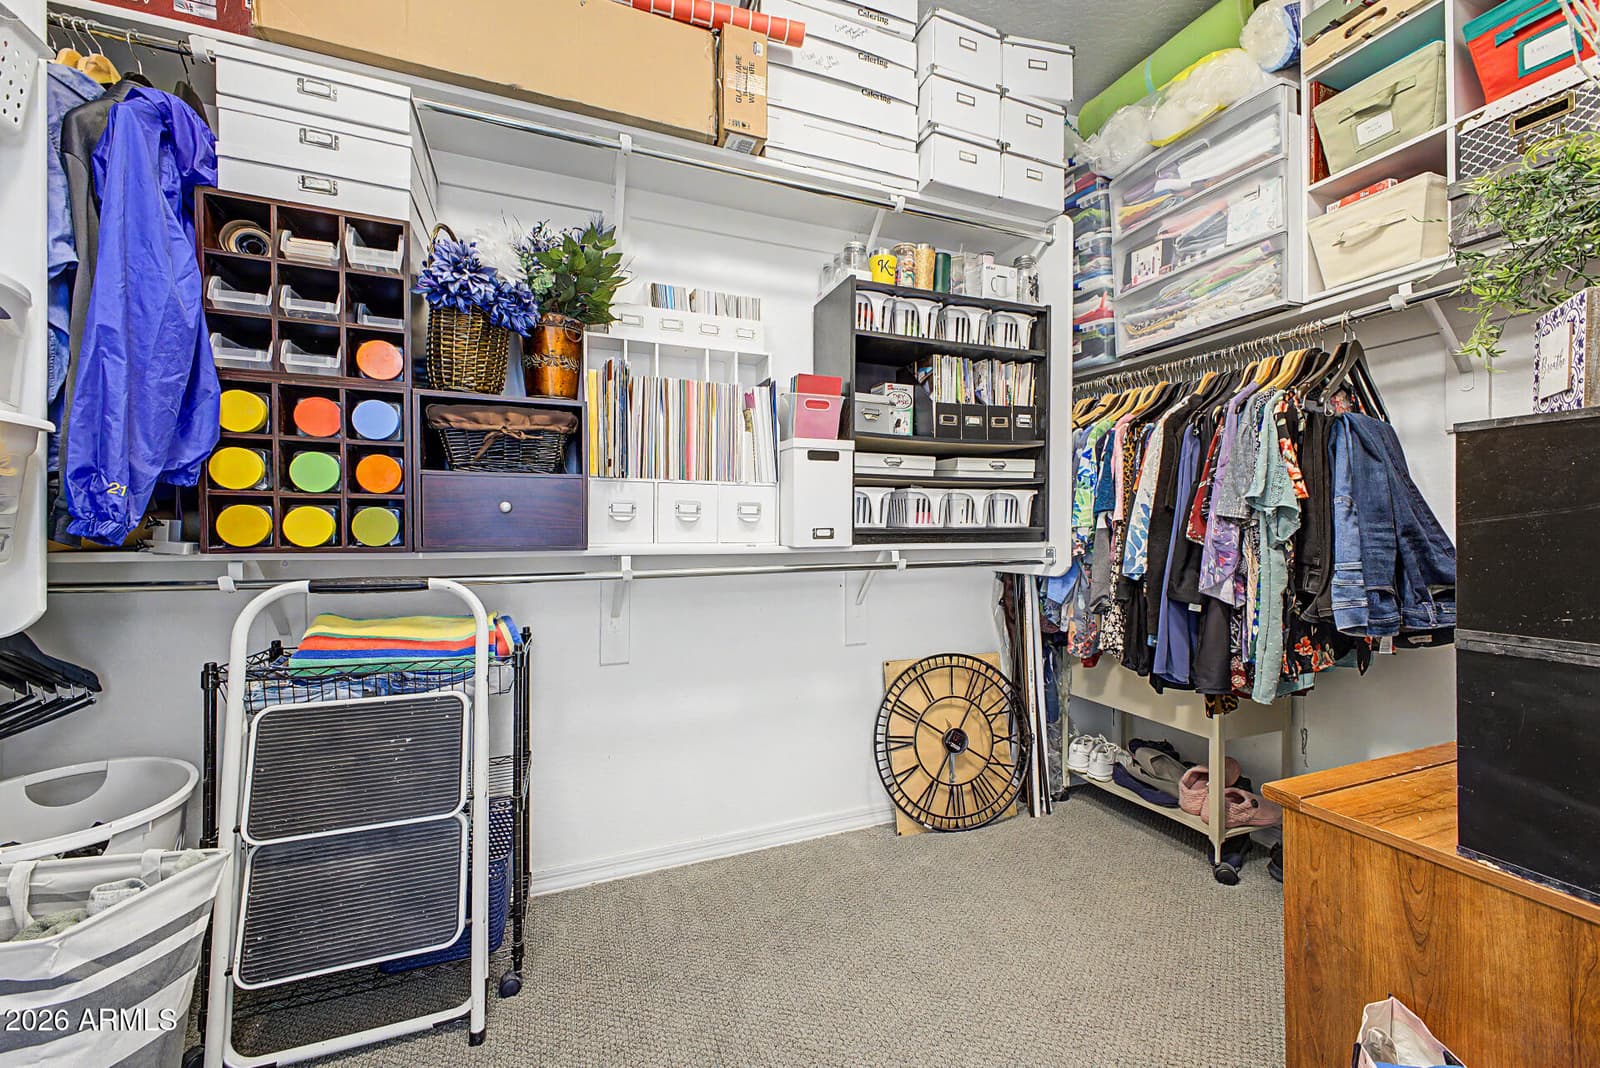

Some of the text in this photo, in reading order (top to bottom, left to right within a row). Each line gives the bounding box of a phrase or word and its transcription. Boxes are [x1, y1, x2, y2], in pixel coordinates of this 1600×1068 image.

[857, 9, 889, 25] Catering
[857, 52, 889, 69] Catering
[861, 88, 892, 104] Catering
[106, 481, 128, 497] 21
